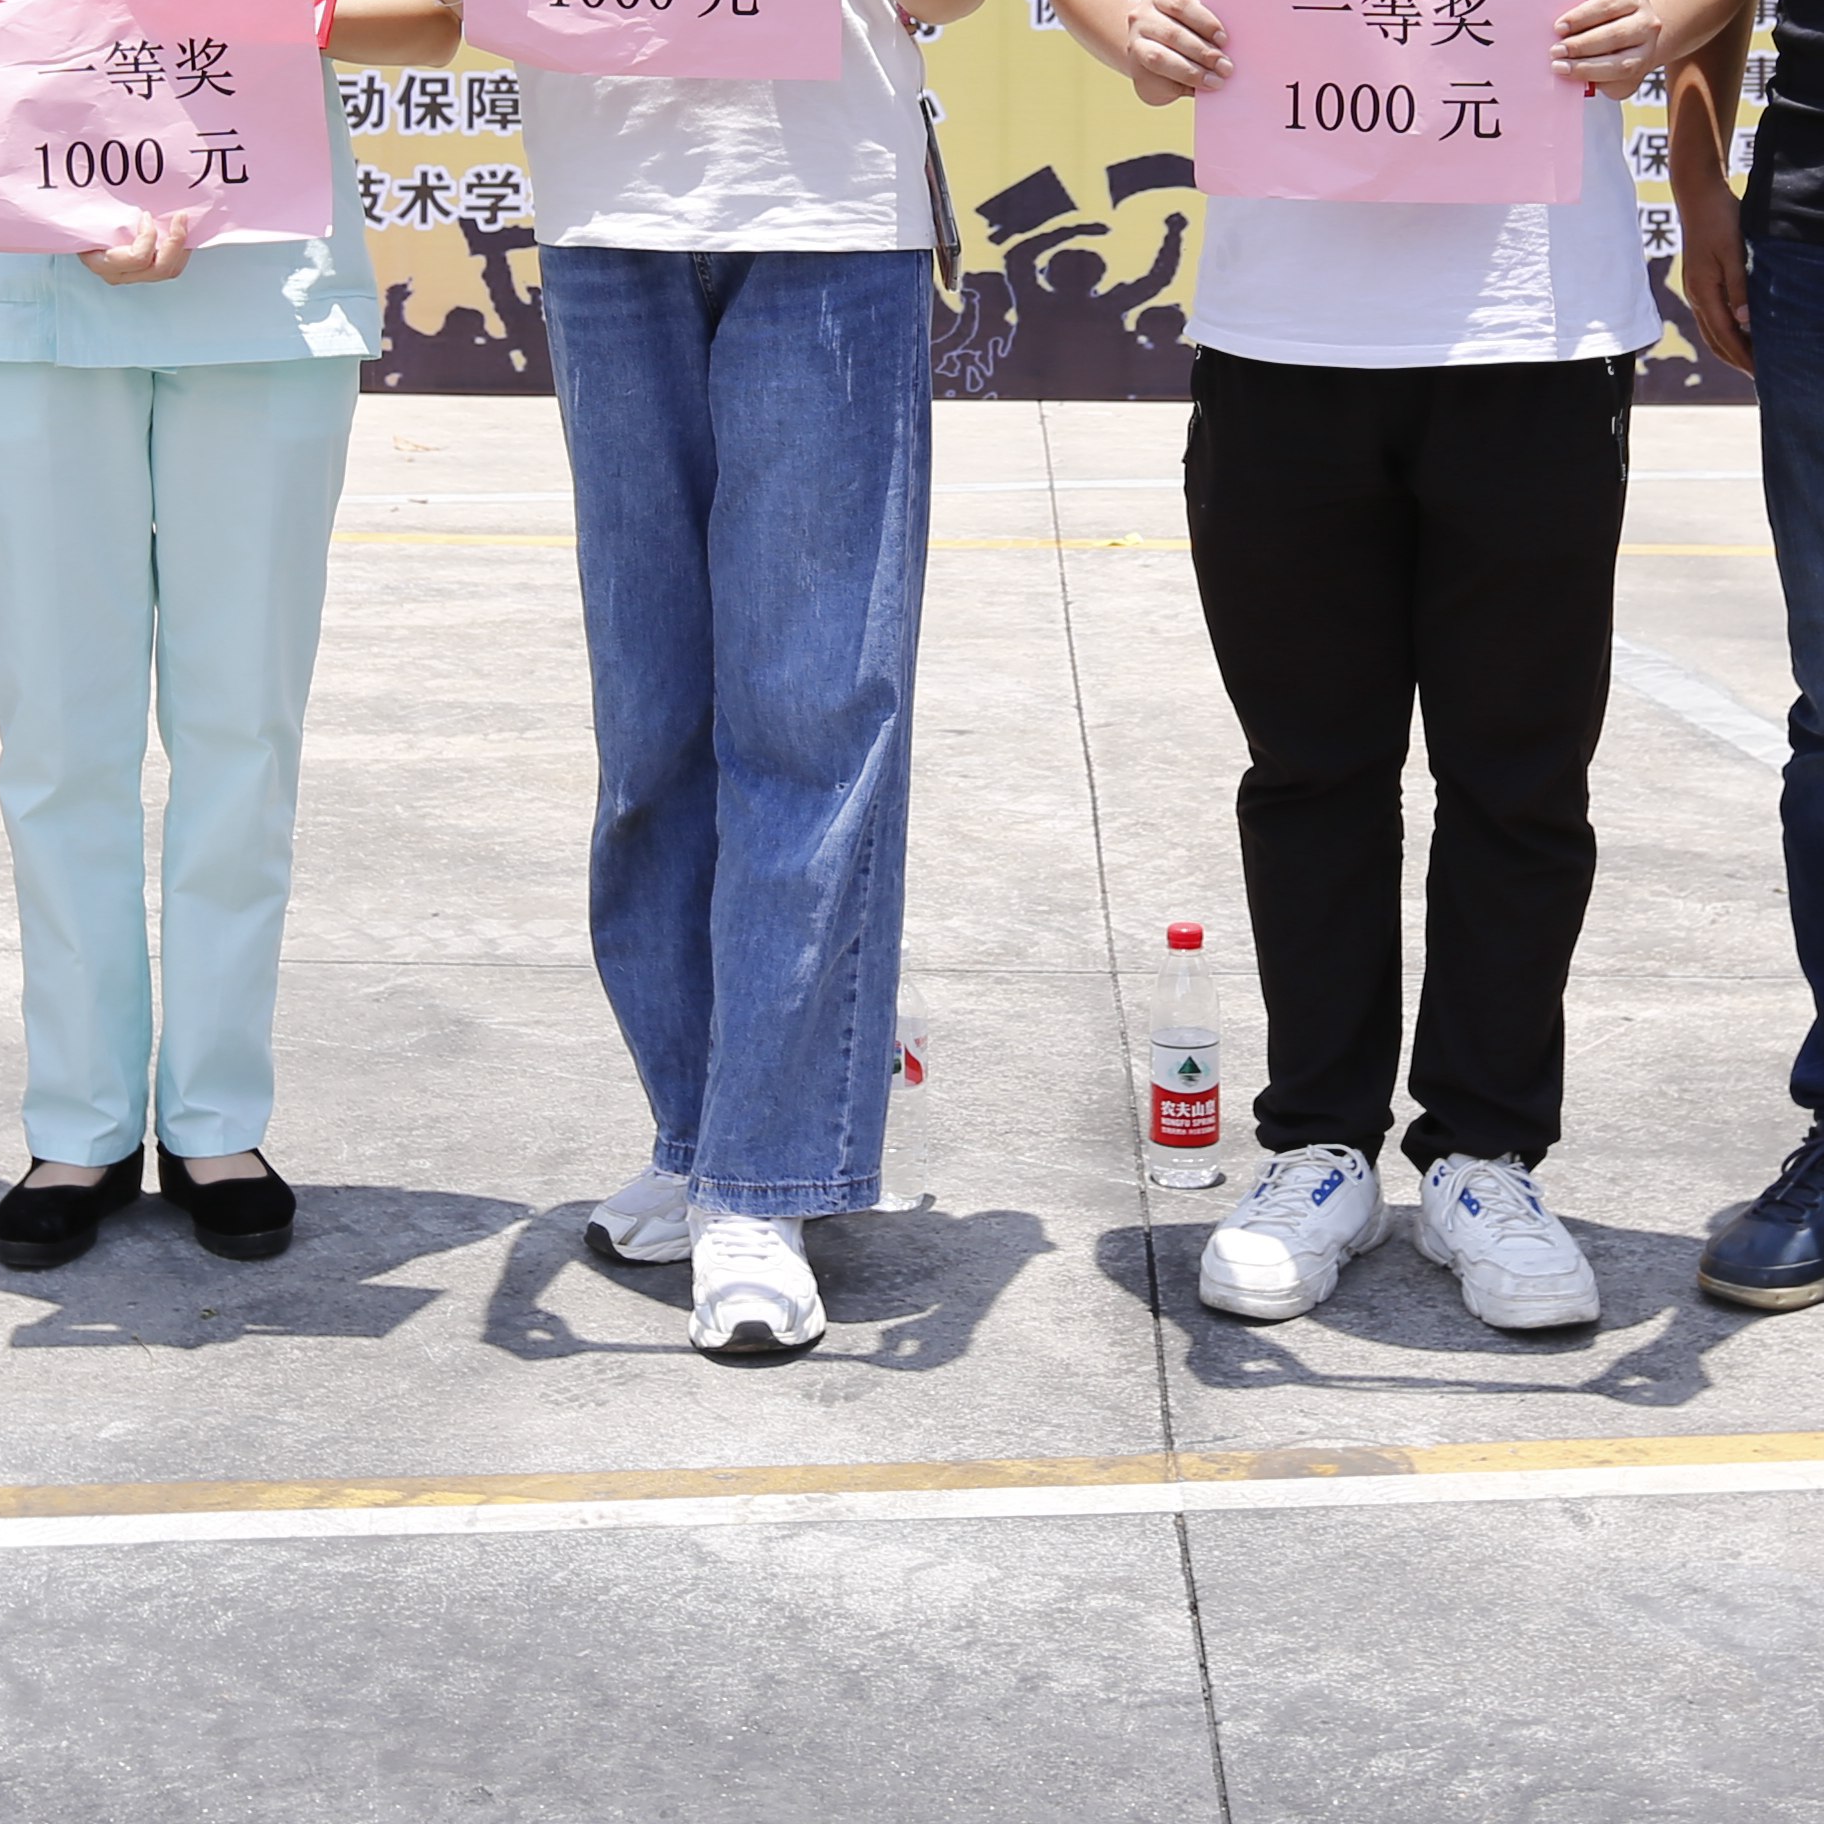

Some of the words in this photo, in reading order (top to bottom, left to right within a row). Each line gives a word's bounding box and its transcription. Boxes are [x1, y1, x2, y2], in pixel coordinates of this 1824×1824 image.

[39, 38, 236, 100] 一等奖
[1286, 82, 1415, 134] 1000
[1440, 81, 1502, 141] 元
[36, 140, 164, 188] 1000
[190, 130, 249, 189] 元
